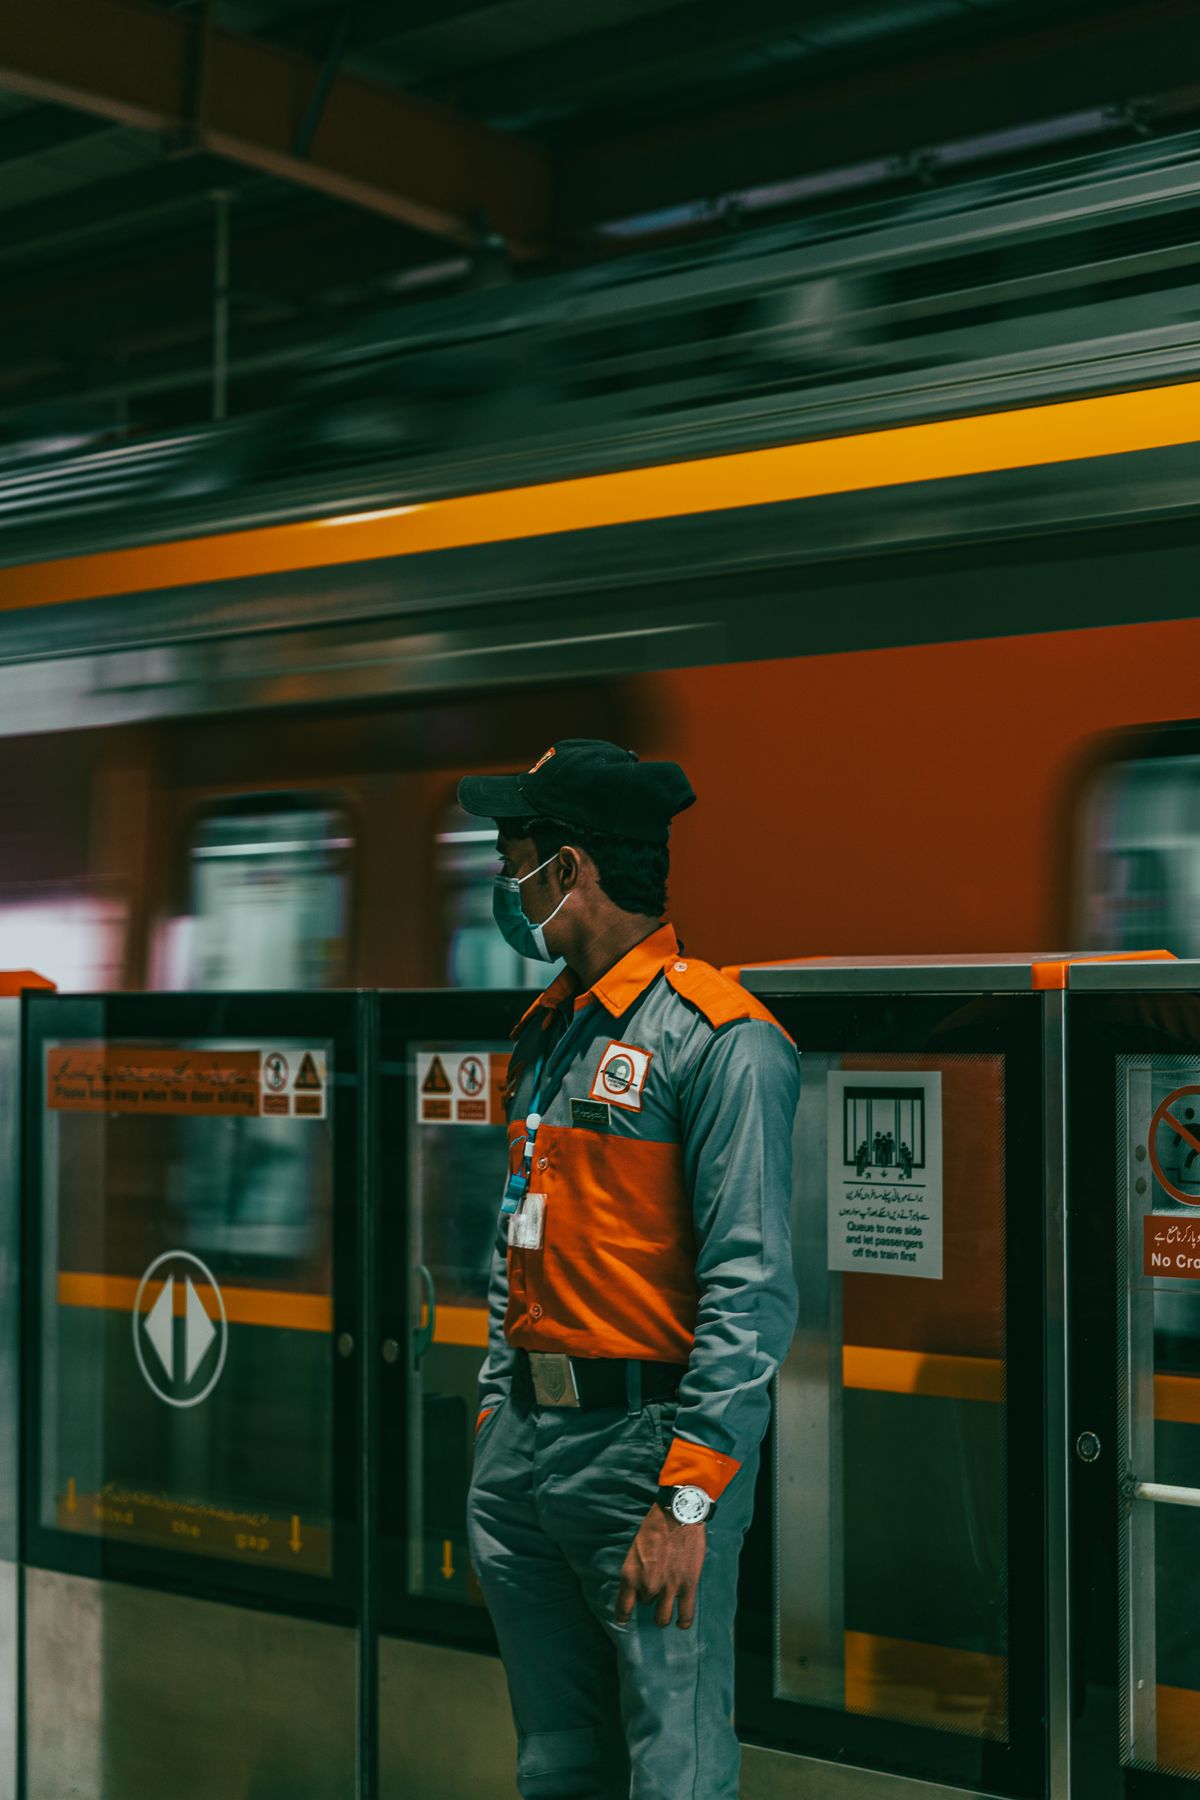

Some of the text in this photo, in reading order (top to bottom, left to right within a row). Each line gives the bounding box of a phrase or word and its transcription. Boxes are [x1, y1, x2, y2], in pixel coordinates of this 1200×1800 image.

[847, 1221, 923, 1236] Queue to one side
[846, 1235, 923, 1250] and let passengers
[852, 1247, 917, 1262] off the train first
[1151, 1252, 1171, 1267] No
